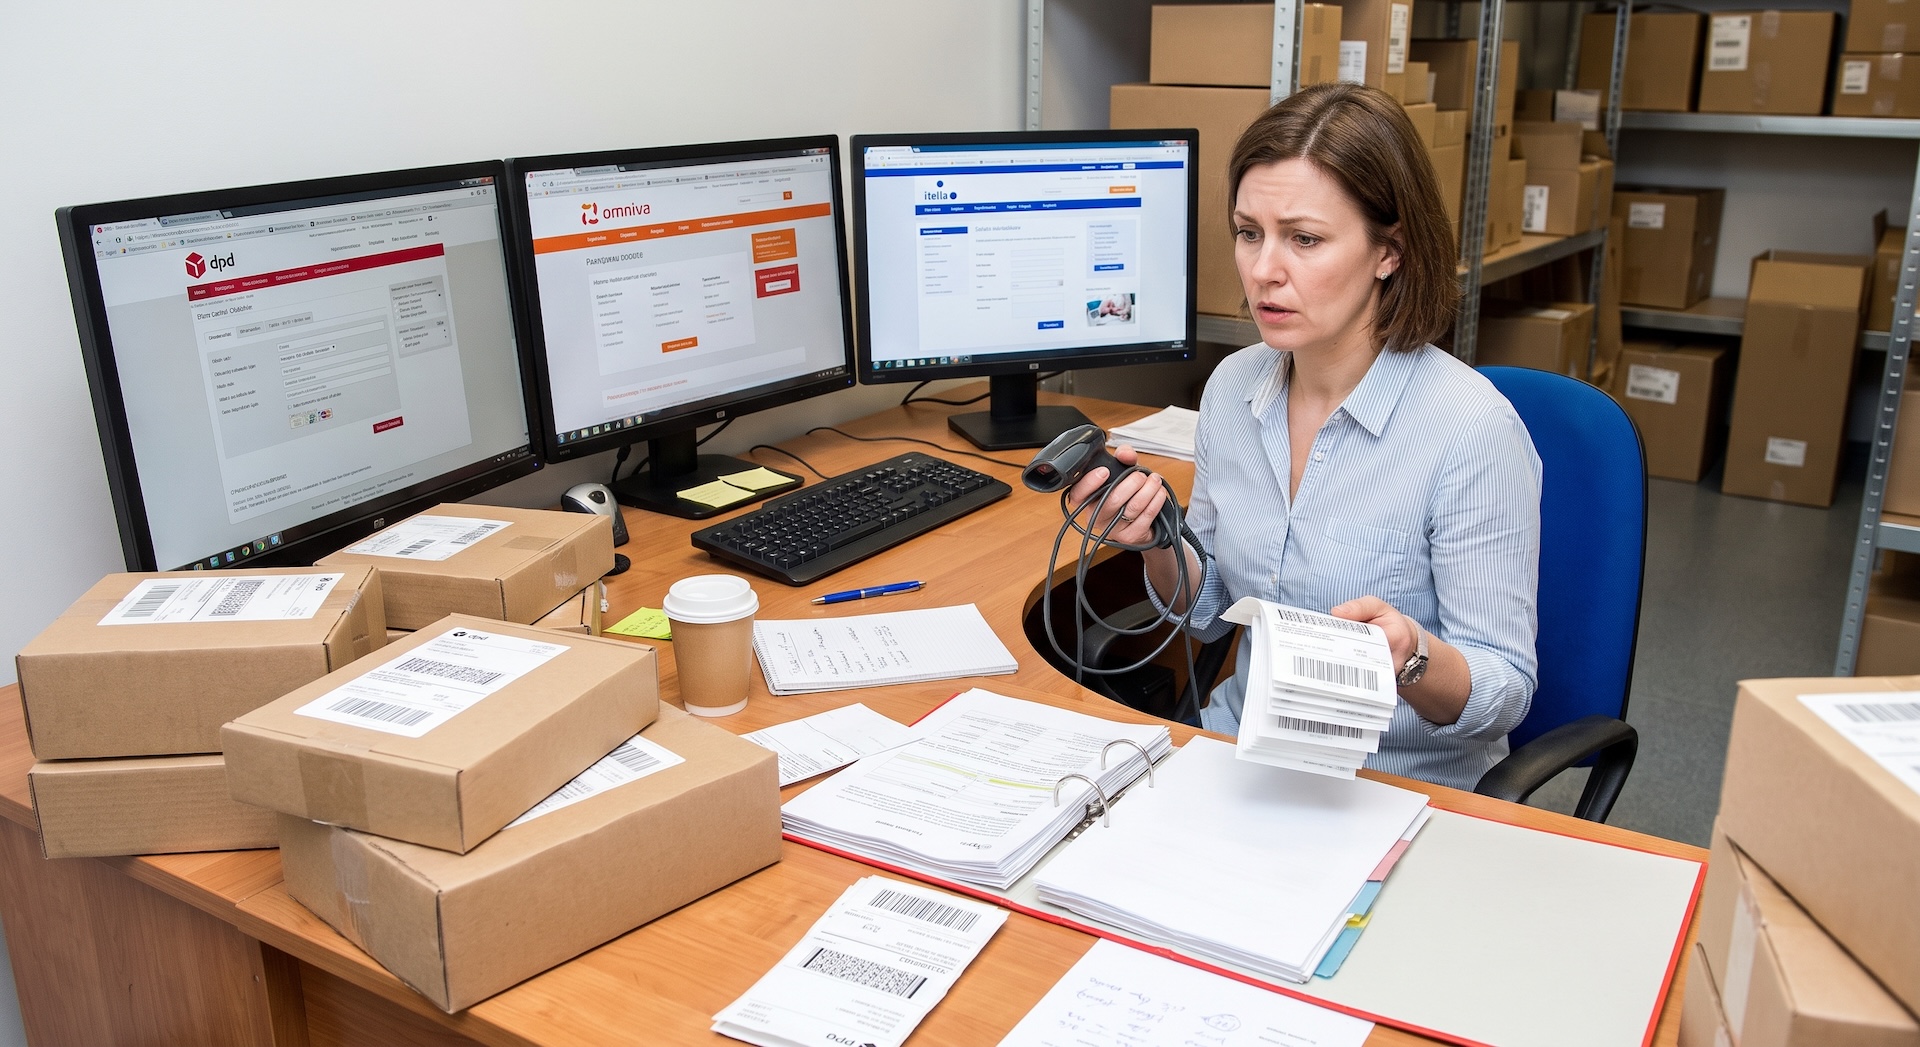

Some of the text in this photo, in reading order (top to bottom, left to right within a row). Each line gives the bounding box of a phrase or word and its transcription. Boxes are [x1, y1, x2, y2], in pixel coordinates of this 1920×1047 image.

[924, 191, 948, 200] itella
[602, 202, 651, 219] omniva
[210, 252, 235, 272] dpd
